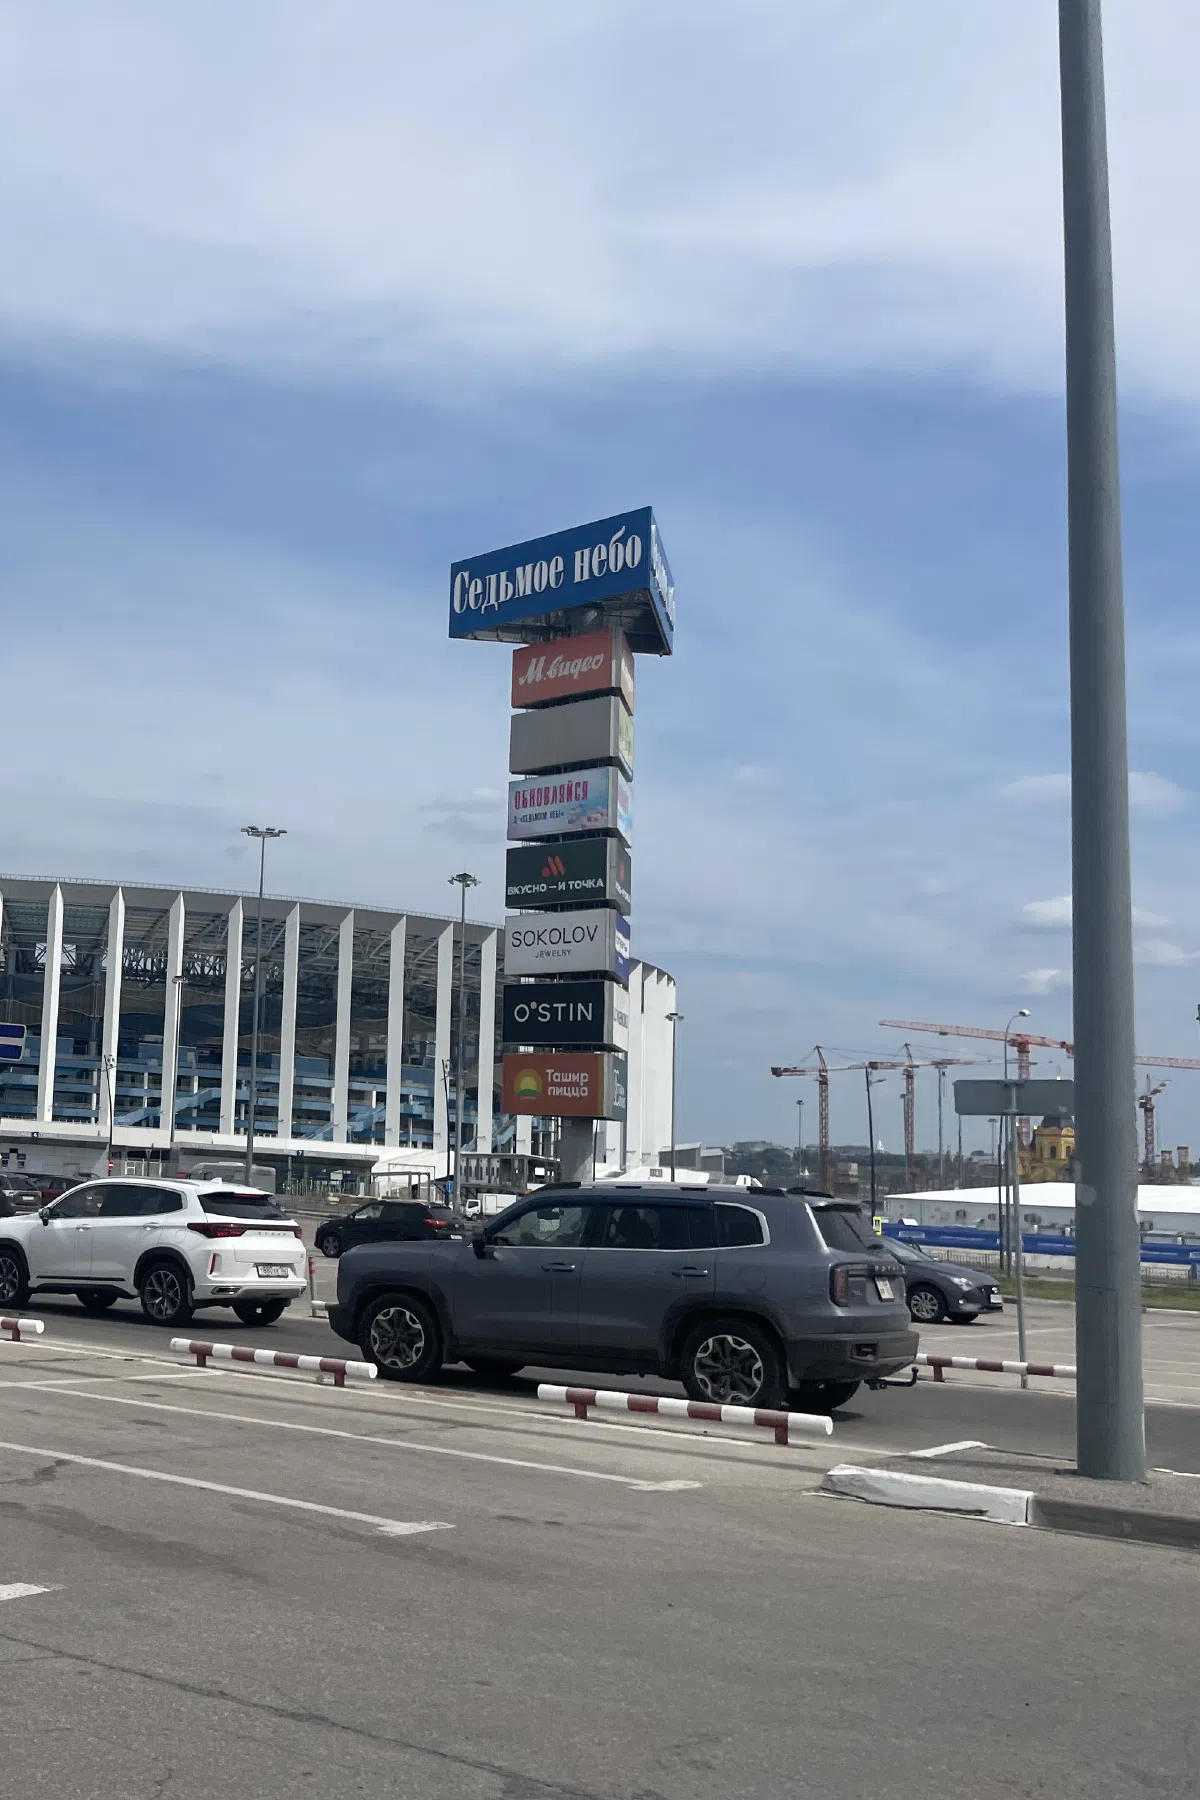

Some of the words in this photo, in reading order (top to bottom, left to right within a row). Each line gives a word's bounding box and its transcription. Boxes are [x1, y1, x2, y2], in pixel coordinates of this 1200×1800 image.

[453, 555, 564, 614] Седьмое
[573, 526, 642, 584] небо
[514, 780, 588, 810] ОБНОВЛЯЙСЯ
[507, 883, 547, 896] ВКУСНО
[558, 881, 566, 891] И
[568, 878, 604, 890] ТОЧКА
[511, 925, 598, 948] SOKOLOV
[535, 949, 572, 959] JEWELRY
[545, 1069, 589, 1086] Ташир
[547, 1086, 589, 1098] пицца
